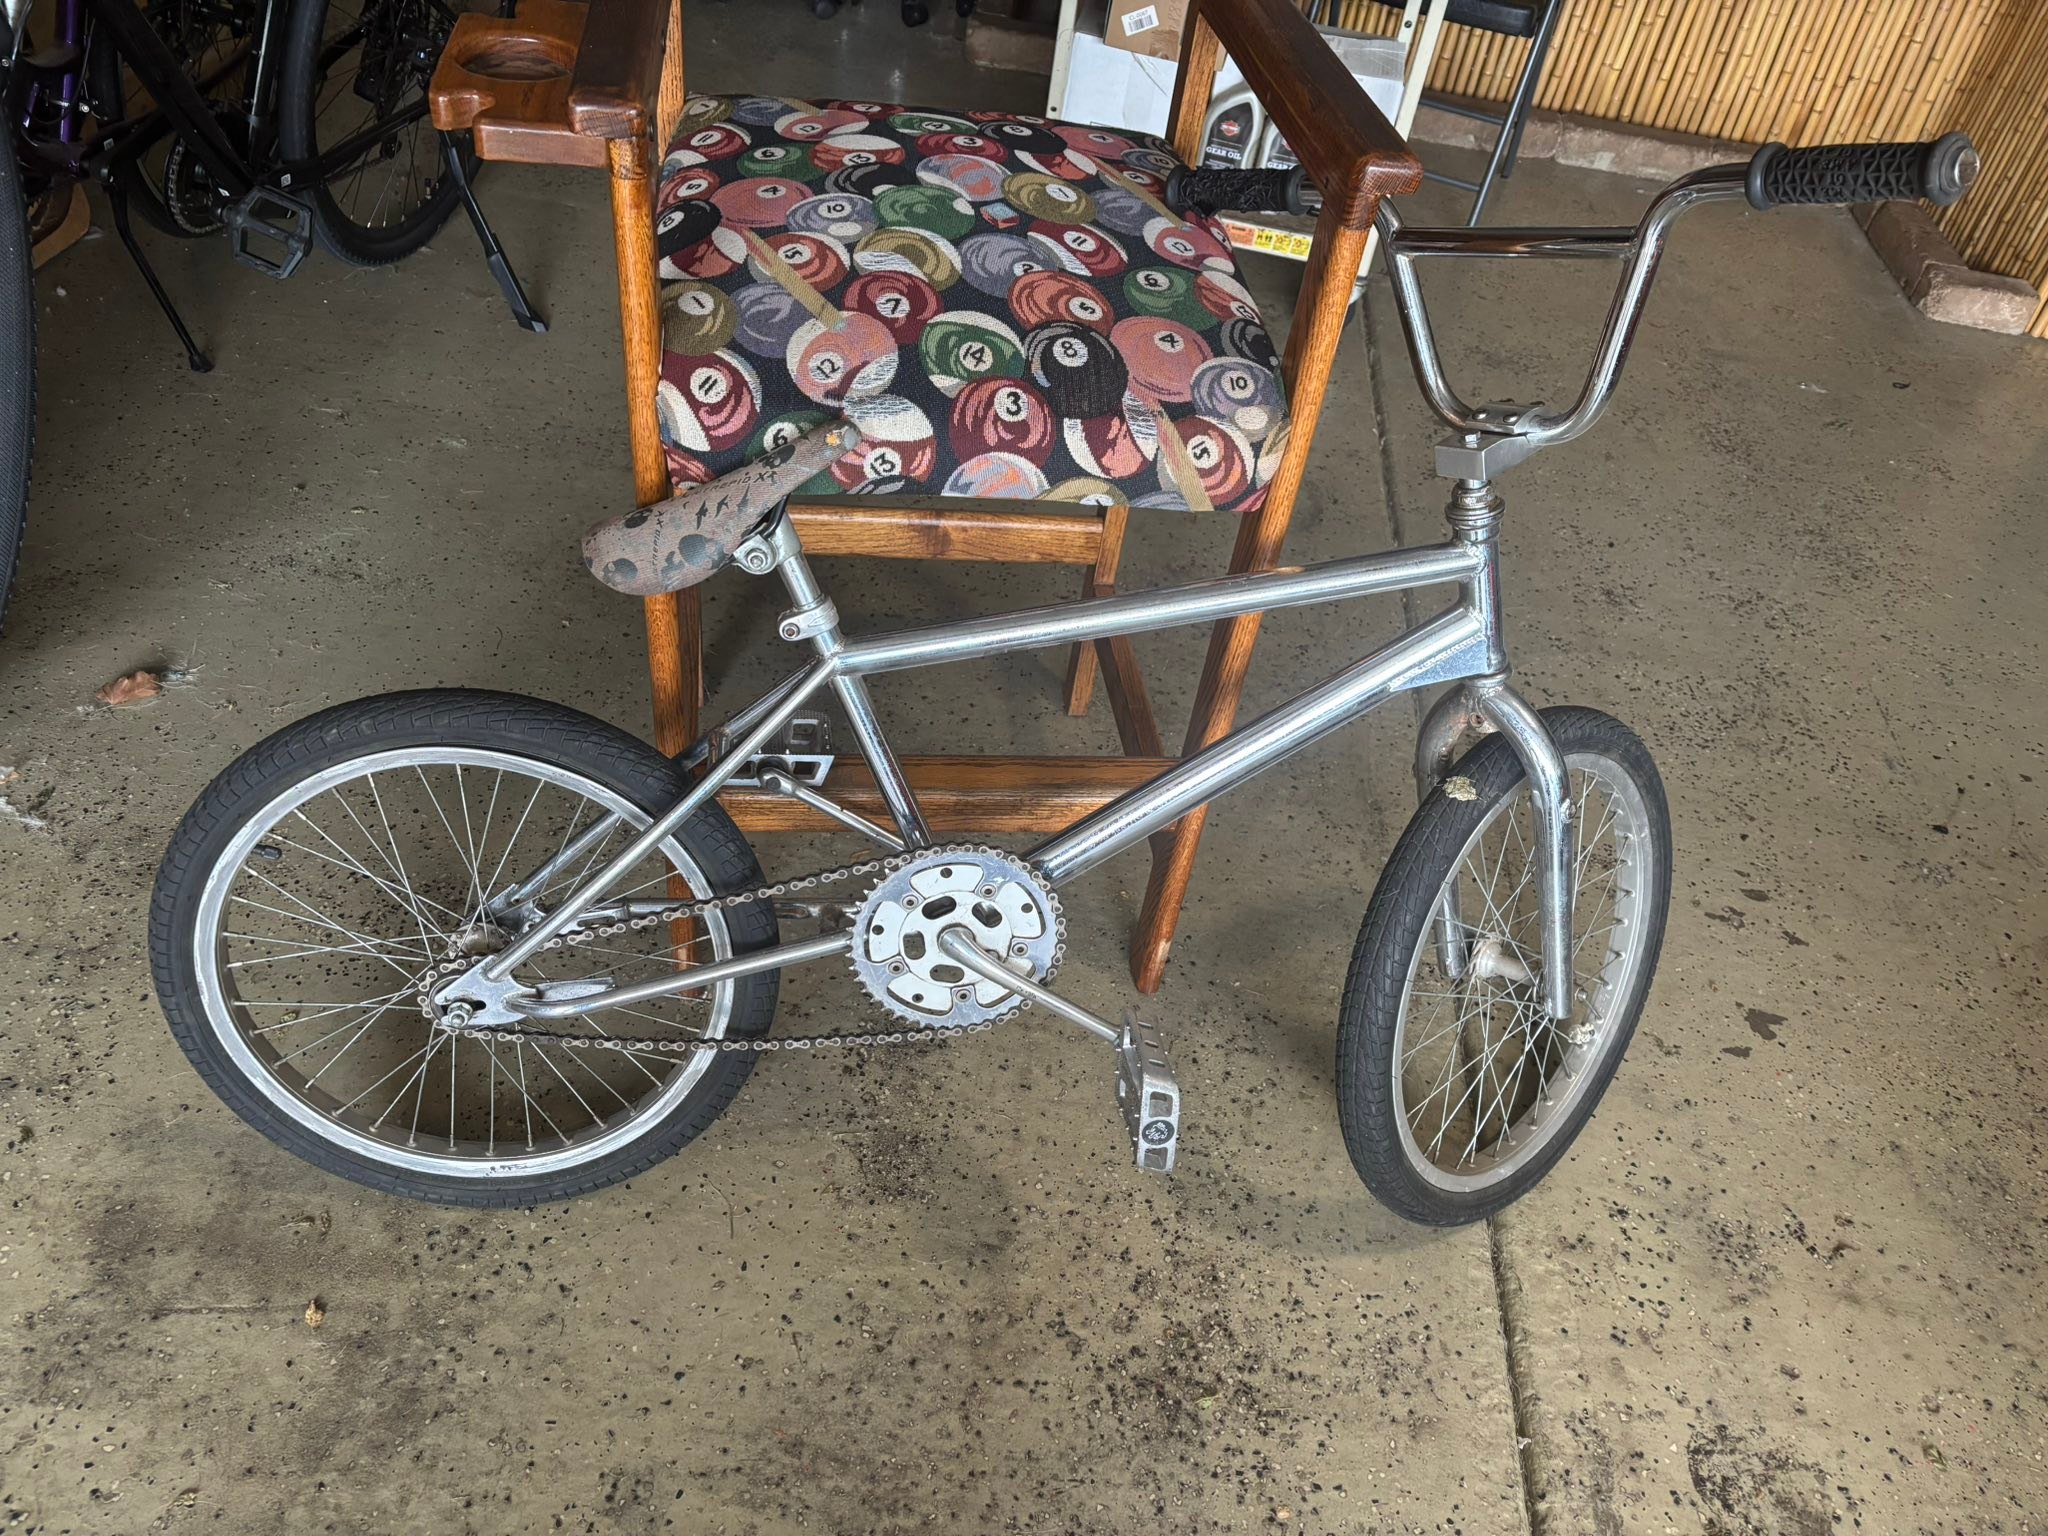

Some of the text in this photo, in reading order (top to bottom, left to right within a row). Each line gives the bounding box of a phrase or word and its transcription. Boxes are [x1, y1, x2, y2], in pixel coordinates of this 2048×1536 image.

[799, 124, 819, 133] 12
[924, 121, 944, 129] 14
[697, 133, 714, 143] 11
[963, 137, 977, 145] 3
[761, 149, 776, 158] 6
[848, 153, 871, 164] 13
[1206, 146, 1226, 157] GEAR
[1227, 150, 1242, 160] OIL
[1153, 156, 1170, 165] 10
[761, 185, 781, 195] 4
[1058, 188, 1069, 198] 1
[827, 203, 845, 214] 10
[663, 216, 675, 227] 8
[1072, 236, 1087, 247] 11
[1171, 241, 1192, 254] 12
[783, 246, 803, 259] 15
[1144, 273, 1163, 287] 6
[692, 295, 705, 309] 1
[885, 298, 902, 315] 7
[1078, 301, 1096, 315] 5
[1236, 305, 1256, 320] 13
[1158, 333, 1179, 348] 4
[962, 344, 986, 368] 14
[1061, 340, 1078, 358] 8
[816, 358, 841, 379] 12
[698, 374, 718, 397] 11
[1229, 376, 1248, 391] 10
[1006, 391, 1021, 416] 3
[772, 428, 788, 449] 6
[1191, 441, 1211, 460] 15
[870, 452, 896, 477] 13
